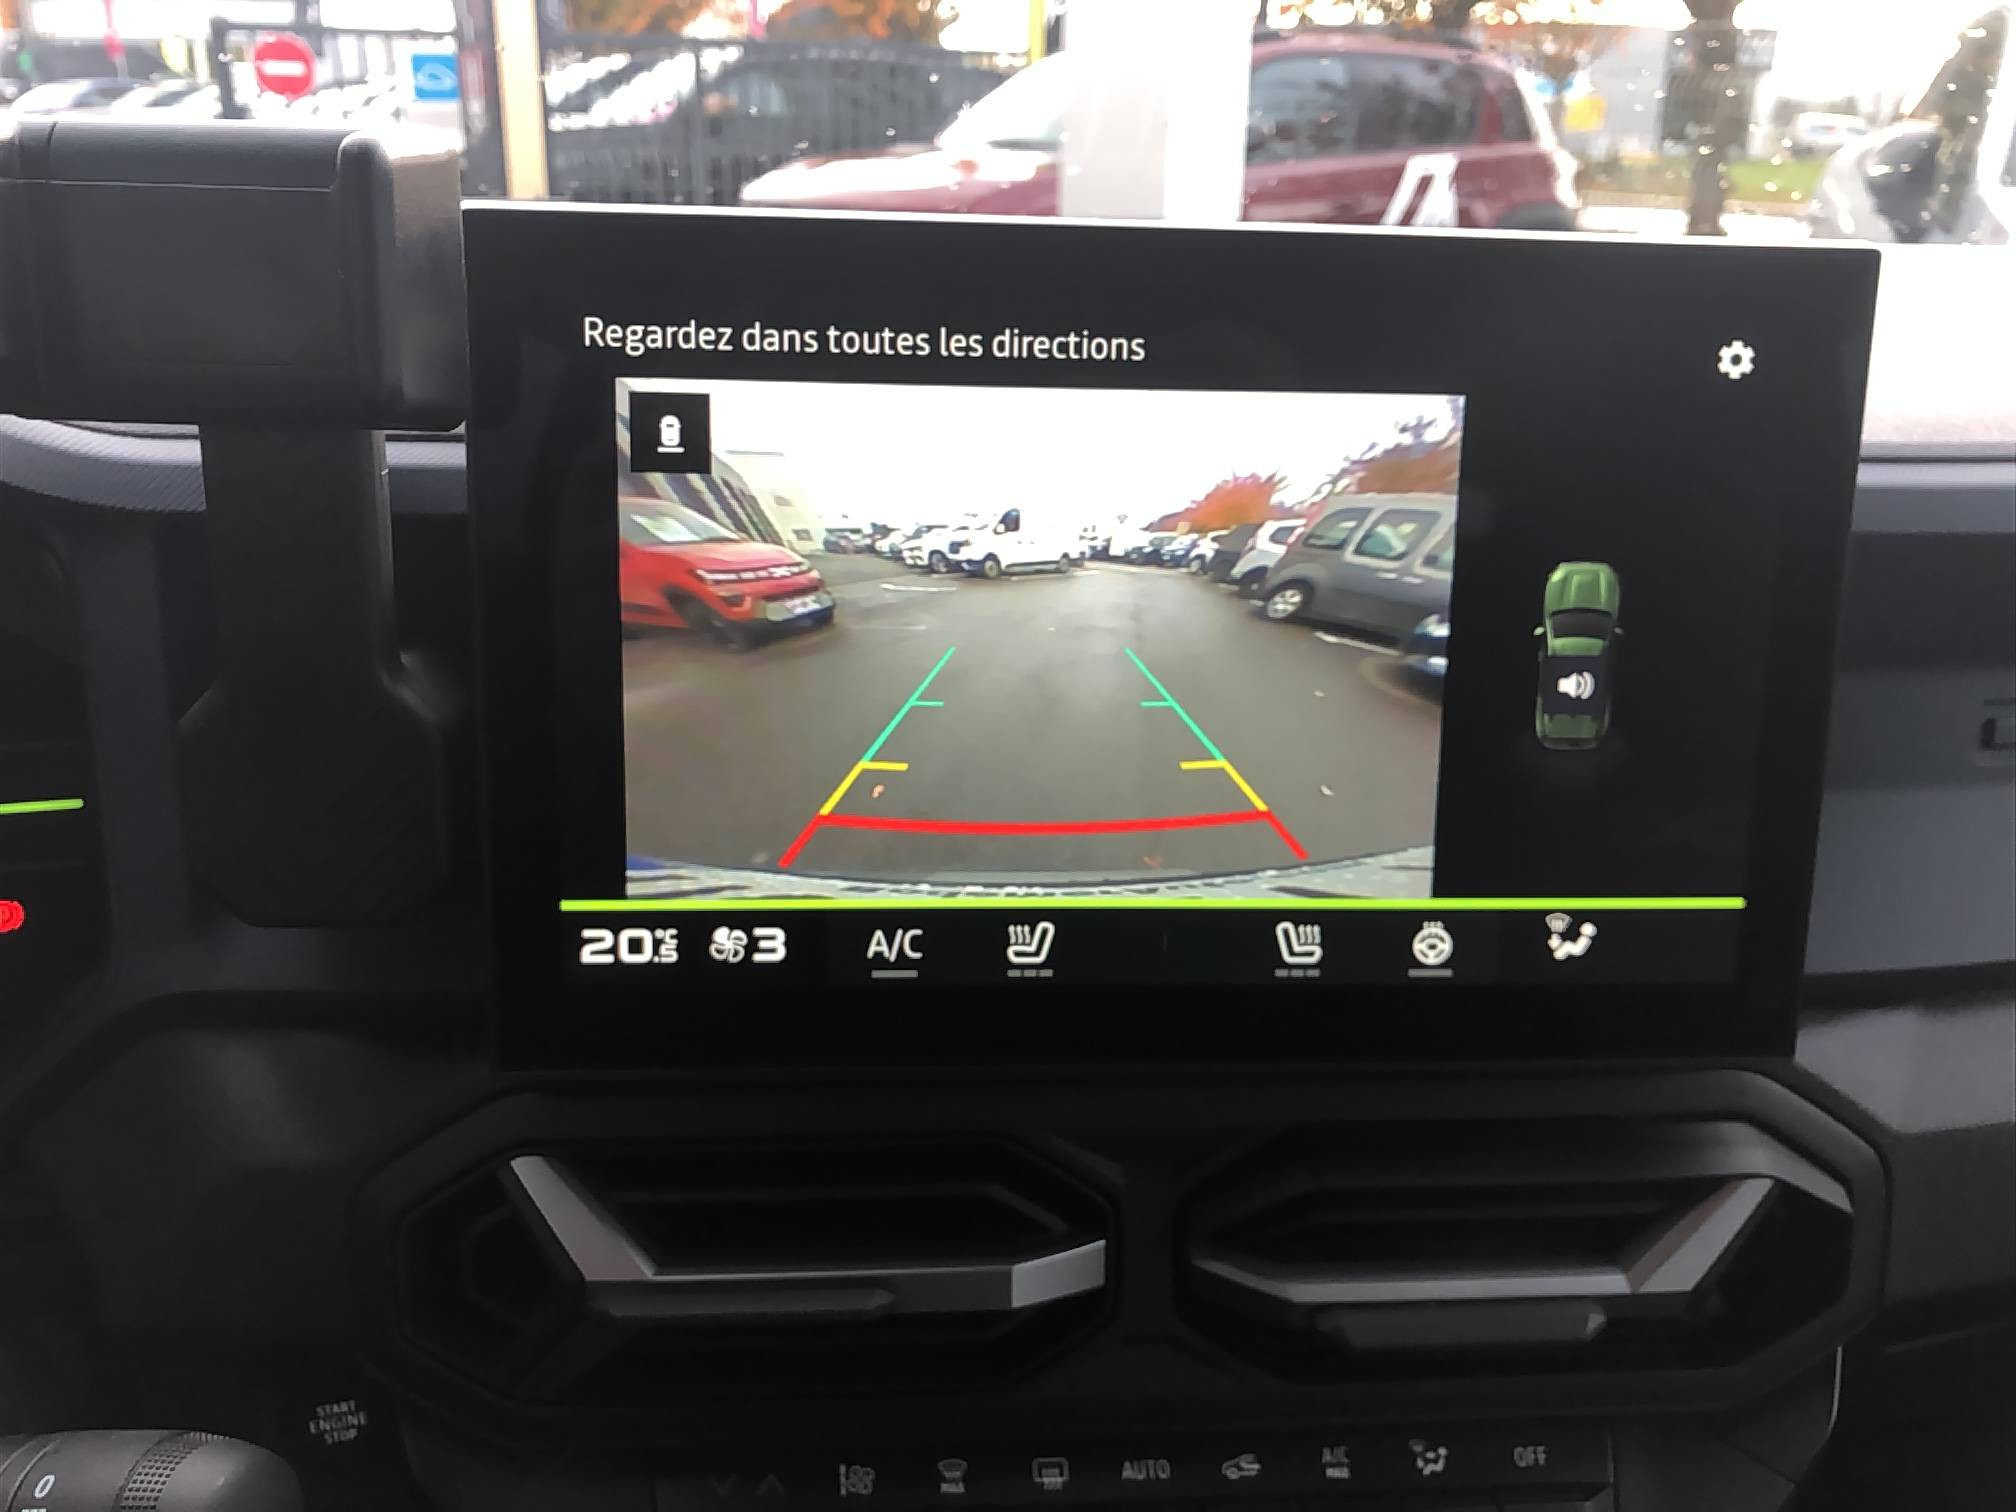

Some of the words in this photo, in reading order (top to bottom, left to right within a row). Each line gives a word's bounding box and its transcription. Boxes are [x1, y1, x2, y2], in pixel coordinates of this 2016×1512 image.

[583, 316, 734, 357] Regardez
[743, 321, 819, 353] dans
[826, 325, 931, 357] toutes
[939, 326, 984, 358] les
[992, 328, 1146, 361] directions
[751, 927, 787, 963] 3
[866, 928, 924, 963] A/C
[316, 1400, 356, 1417] START
[309, 1411, 367, 1434] ENGINE
[323, 1428, 358, 1445] STOP
[1513, 1445, 1547, 1468] OFF
[1121, 1458, 1171, 1480] AUTO
[34, 1474, 56, 1499] 0
